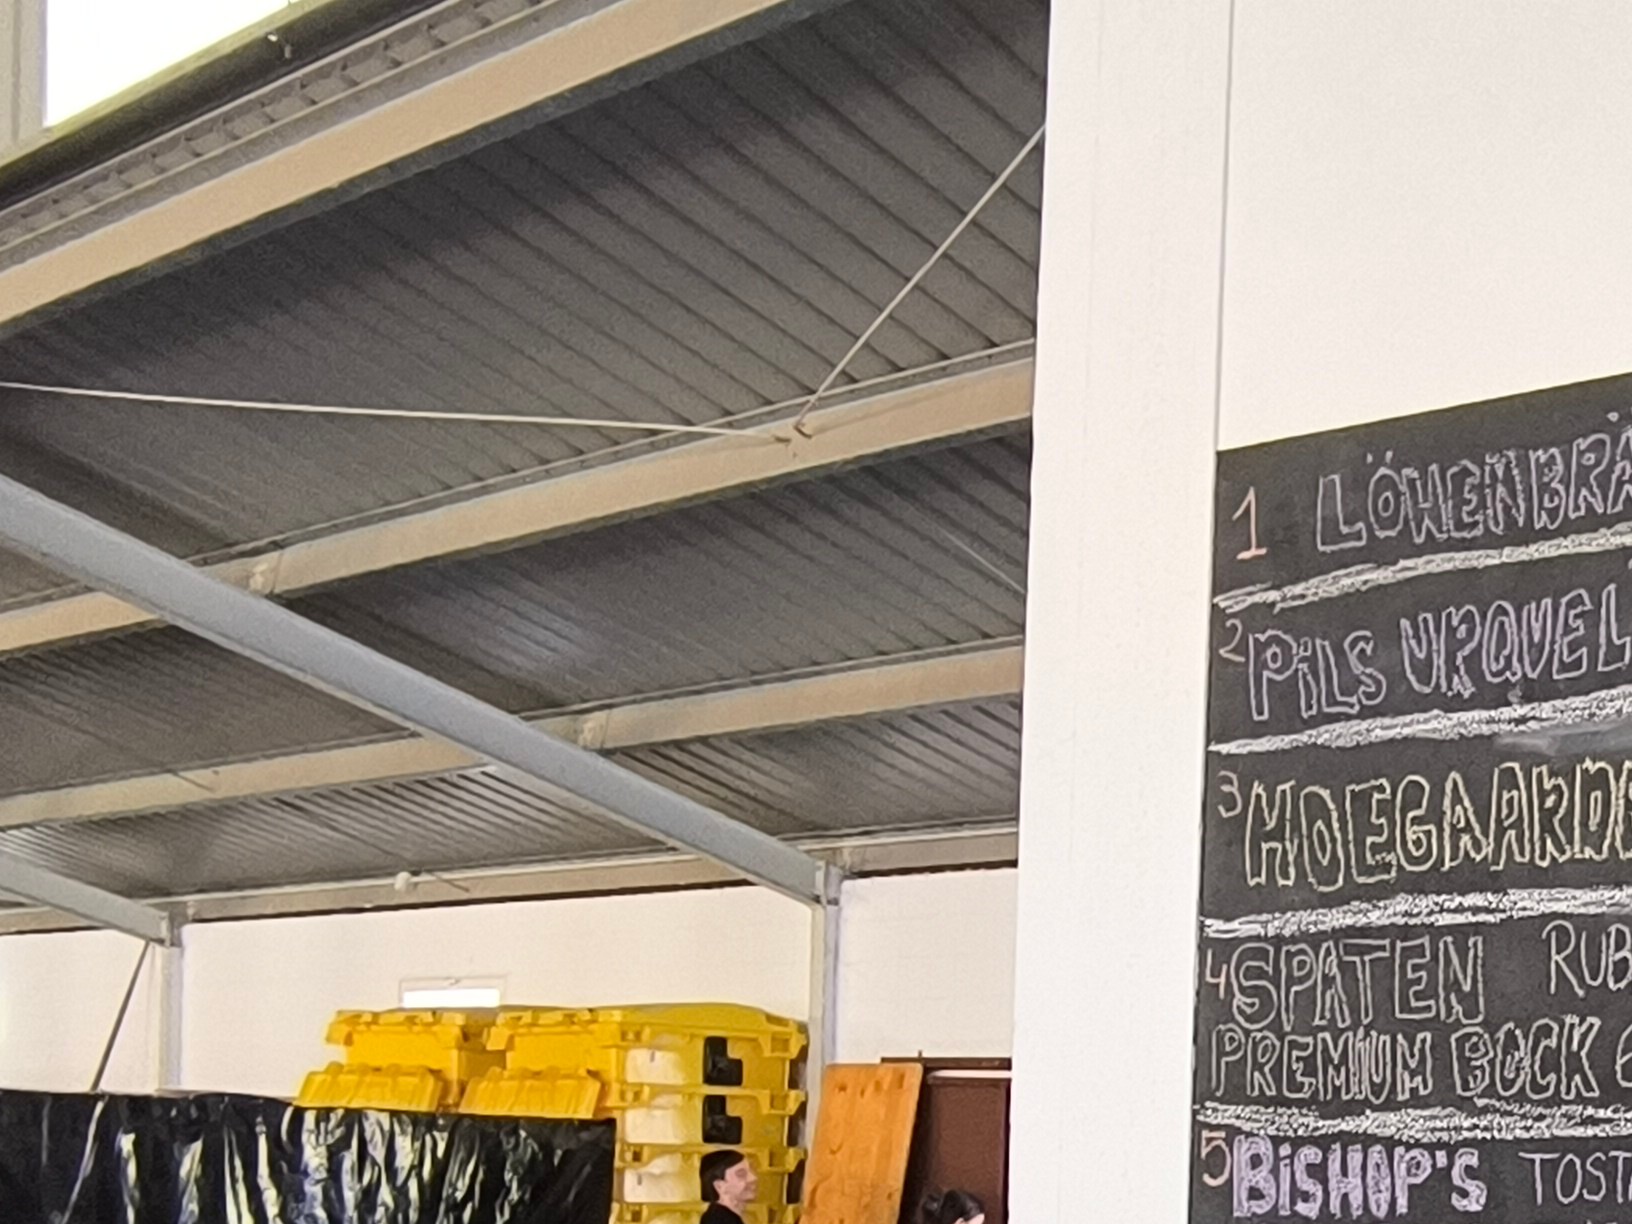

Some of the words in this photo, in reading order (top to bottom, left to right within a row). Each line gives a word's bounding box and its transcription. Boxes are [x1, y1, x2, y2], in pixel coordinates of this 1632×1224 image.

[1232, 485, 1268, 561] 1
[1218, 617, 1246, 663] 2
[1216, 770, 1243, 818] 3
[1204, 947, 1229, 1000] 4
[1229, 934, 1486, 1031] SPATEN
[1449, 1013, 1602, 1100] BOCK
[1200, 1129, 1231, 1187] 5
